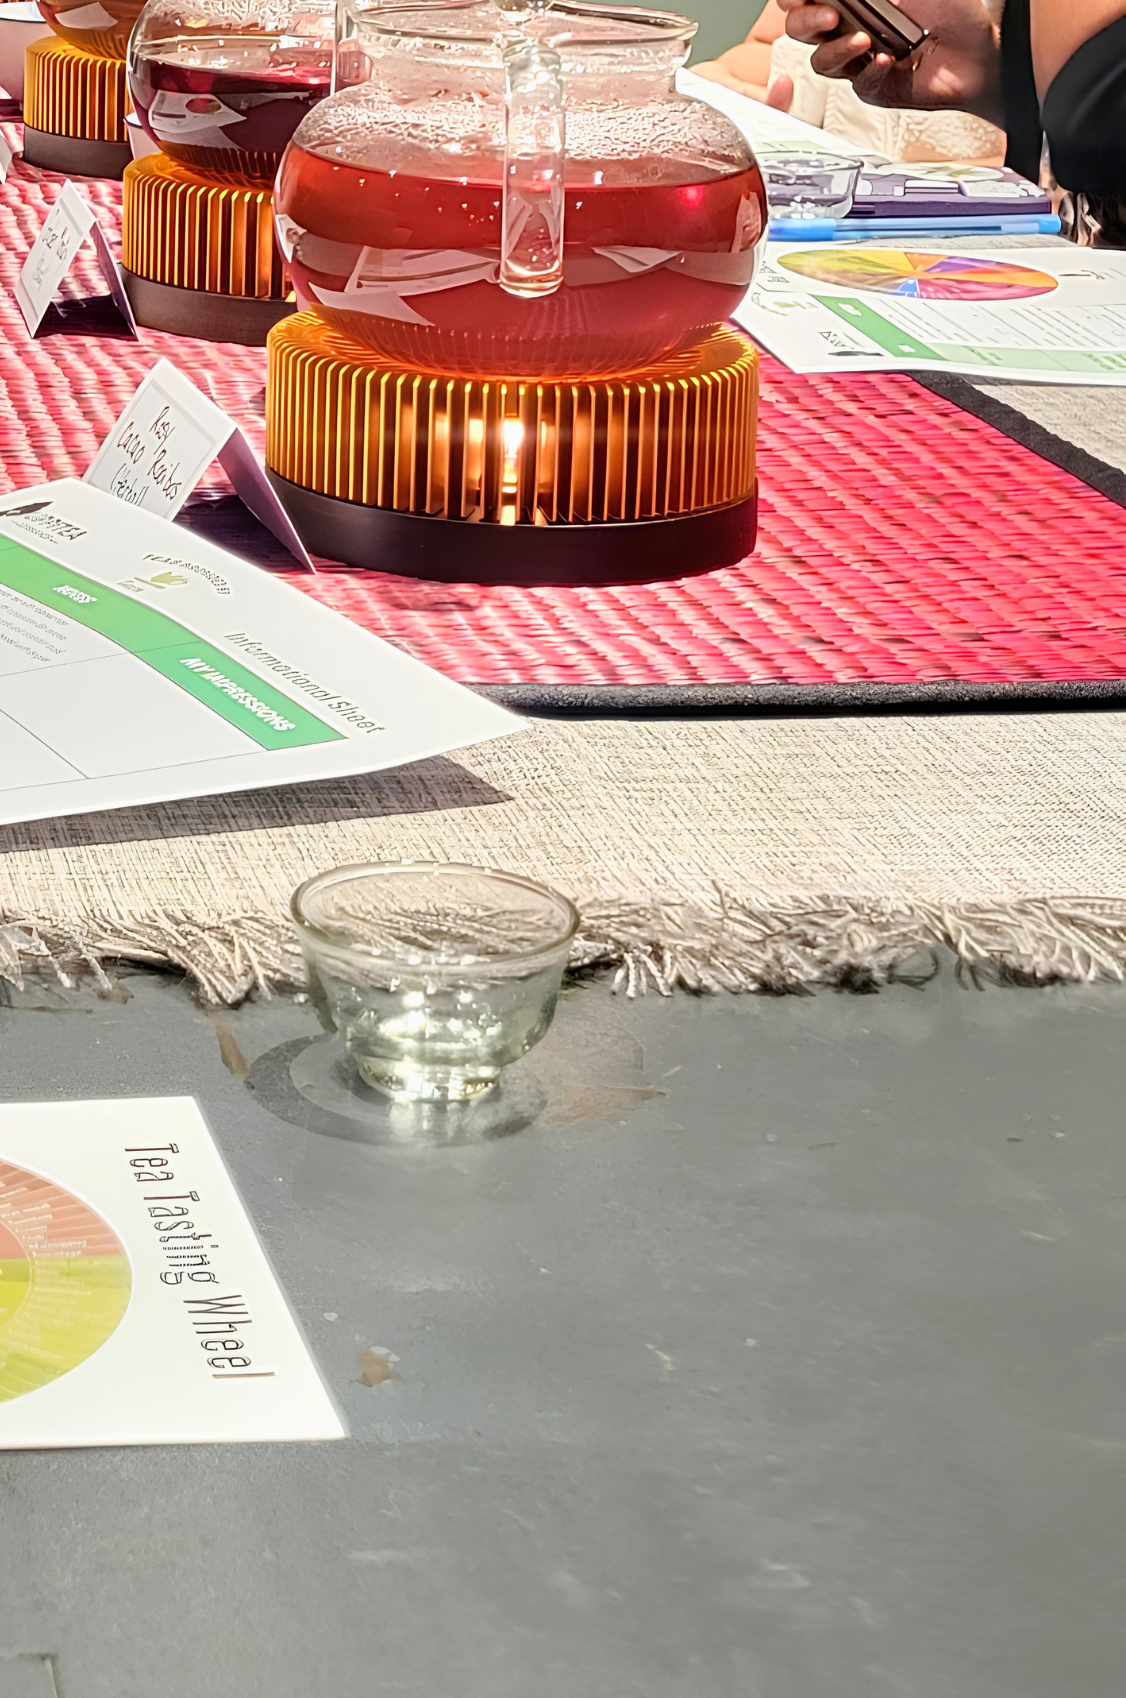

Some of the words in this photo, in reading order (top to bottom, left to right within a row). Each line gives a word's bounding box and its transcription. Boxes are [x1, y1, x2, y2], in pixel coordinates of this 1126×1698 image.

[117, 421, 145, 464] Cacao
[224, 632, 341, 702] Informational
[327, 701, 386, 734] Sheet
[124, 1143, 179, 1182] Tea
[143, 1191, 220, 1285] Tasting
[183, 1294, 275, 1380] Wheel
